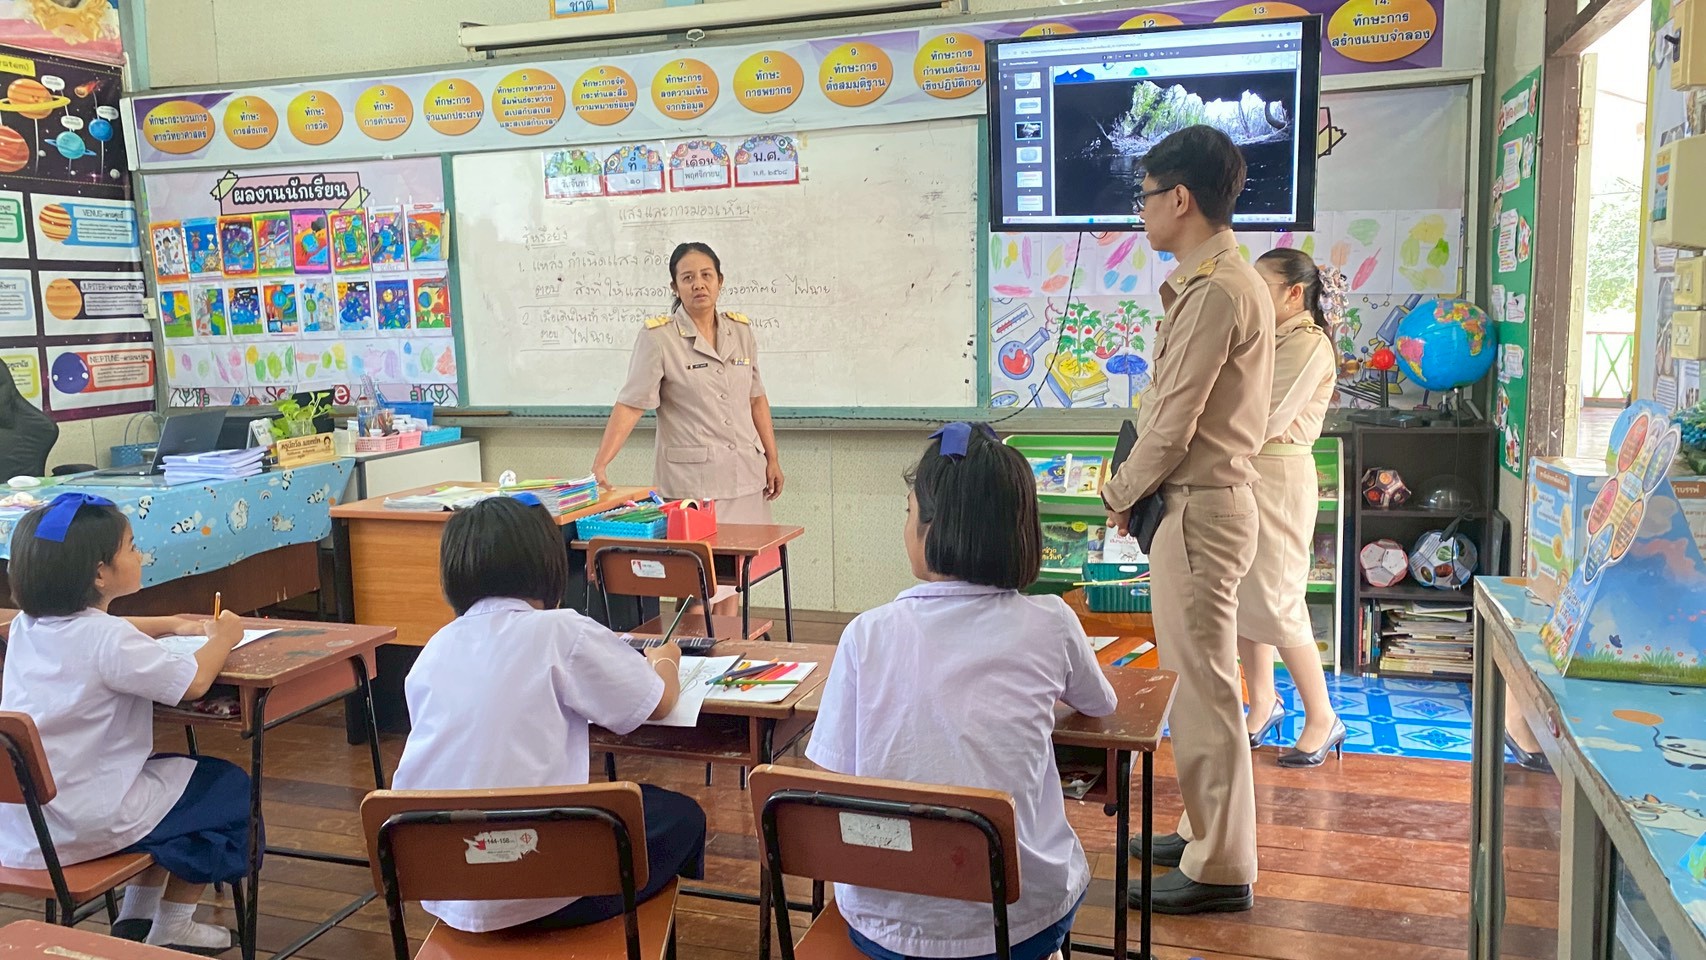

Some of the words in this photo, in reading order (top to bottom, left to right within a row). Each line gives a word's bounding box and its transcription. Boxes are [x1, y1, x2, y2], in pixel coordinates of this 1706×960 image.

[570, 0, 594, 12] ชาต
[1353, 12, 1409, 26] ทักษะการ
[1332, 28, 1430, 48] สร้างแบบจำลอง
[931, 50, 972, 60] ทักษะการ
[833, 62, 877, 74] ทักษะการ
[922, 62, 980, 76] กำหนดนิยาม
[665, 74, 702, 84] ทักษะการ
[756, 70, 780, 80] ทักษะ
[582, 76, 626, 88] ทักษะการจัด
[826, 75, 886, 93] ตั้งสมมุติฐาน
[922, 77, 982, 92] เชิงปฏิบัติการ
[497, 84, 556, 94] ทักษะการหาความ
[581, 88, 628, 100] กระทำและสื่อ
[661, 86, 708, 98] ลงความเห็น
[434, 96, 470, 106] ทักษะการ
[502, 95, 552, 105] สัมพันธ์ระหว่าง
[575, 100, 636, 112] ความหมายข้อมูล
[666, 100, 704, 112] จากข้อมูล
[304, 106, 324, 116] ทักษะ
[374, 101, 394, 112] ทักษะ
[504, 106, 551, 116] สเปสกับสเปส
[148, 112, 208, 126] ทักษะกระบวนการ
[240, 112, 260, 122] ทักษะ
[364, 116, 406, 126] การคำนวณ
[426, 110, 482, 122] จำแนกประเภท
[233, 125, 268, 136] การสังเกต
[305, 120, 328, 130] การวัด
[153, 126, 207, 142] ทางวิทยาศาสตร์
[628, 152, 637, 170] ที่
[686, 154, 714, 168] เดือน
[754, 151, 780, 162] พ.ศ.
[234, 174, 348, 204] ผลงานนักเรียน
